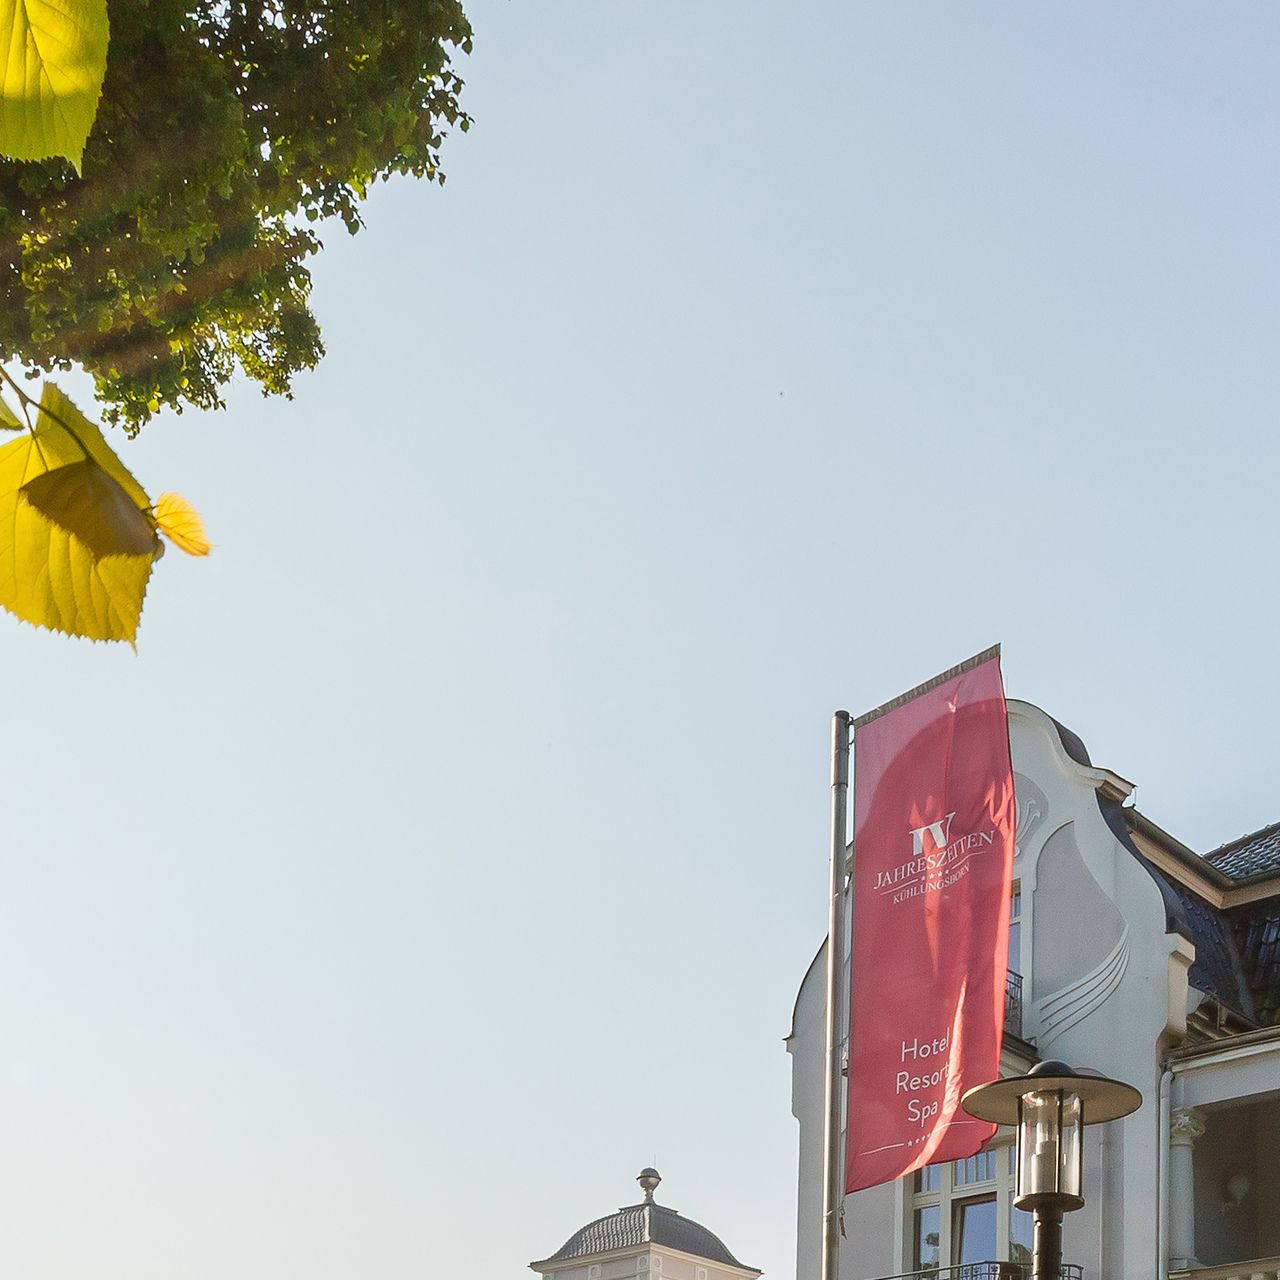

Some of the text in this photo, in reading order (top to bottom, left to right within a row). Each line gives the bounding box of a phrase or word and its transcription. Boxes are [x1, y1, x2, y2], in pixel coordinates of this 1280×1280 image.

[873, 830, 996, 890] JAHRESZEITEN
[893, 863, 971, 905] KÜHLUNGSBORN
[901, 1026, 951, 1062] Hotel
[896, 1061, 950, 1095] Resort
[908, 1099, 938, 1128] Spa
